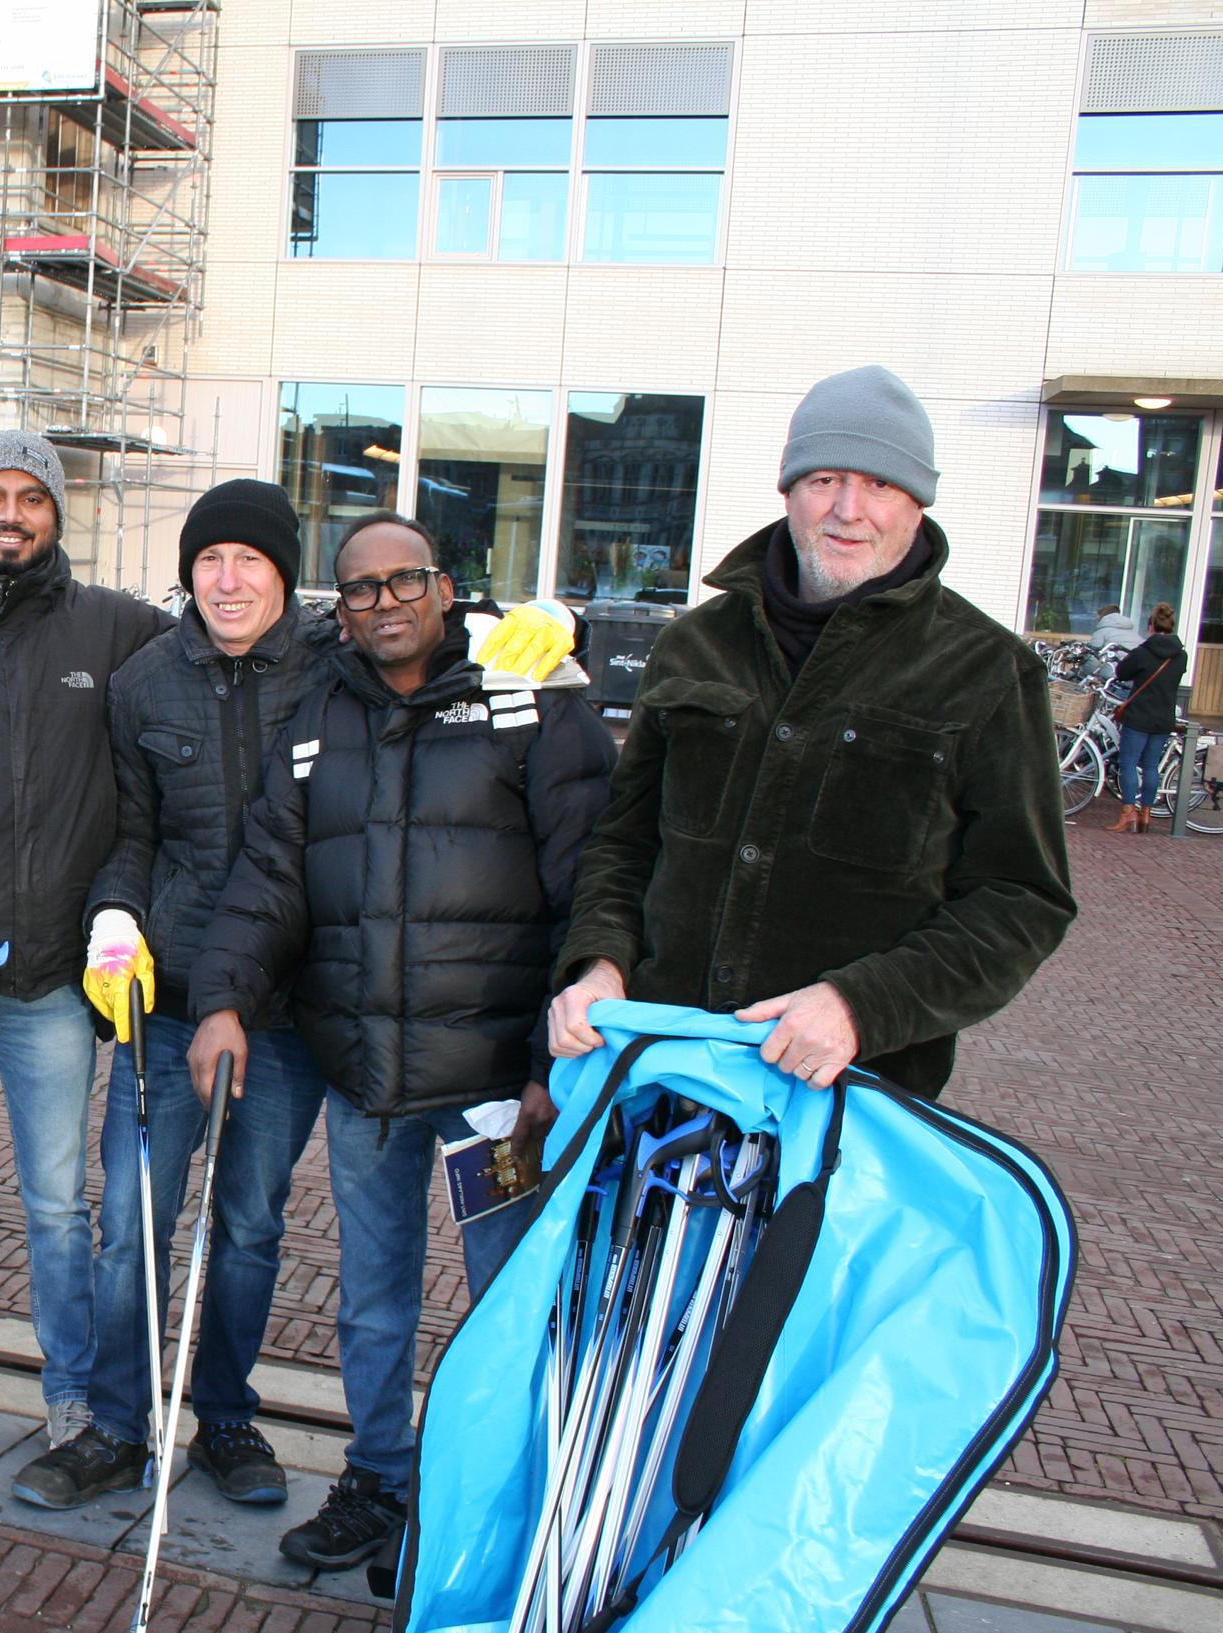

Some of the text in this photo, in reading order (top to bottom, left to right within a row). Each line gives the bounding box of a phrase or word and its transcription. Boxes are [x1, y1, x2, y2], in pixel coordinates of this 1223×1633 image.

[451, 701, 470, 710] THE
[435, 709, 470, 719] NORTH
[443, 716, 469, 725] FACE
